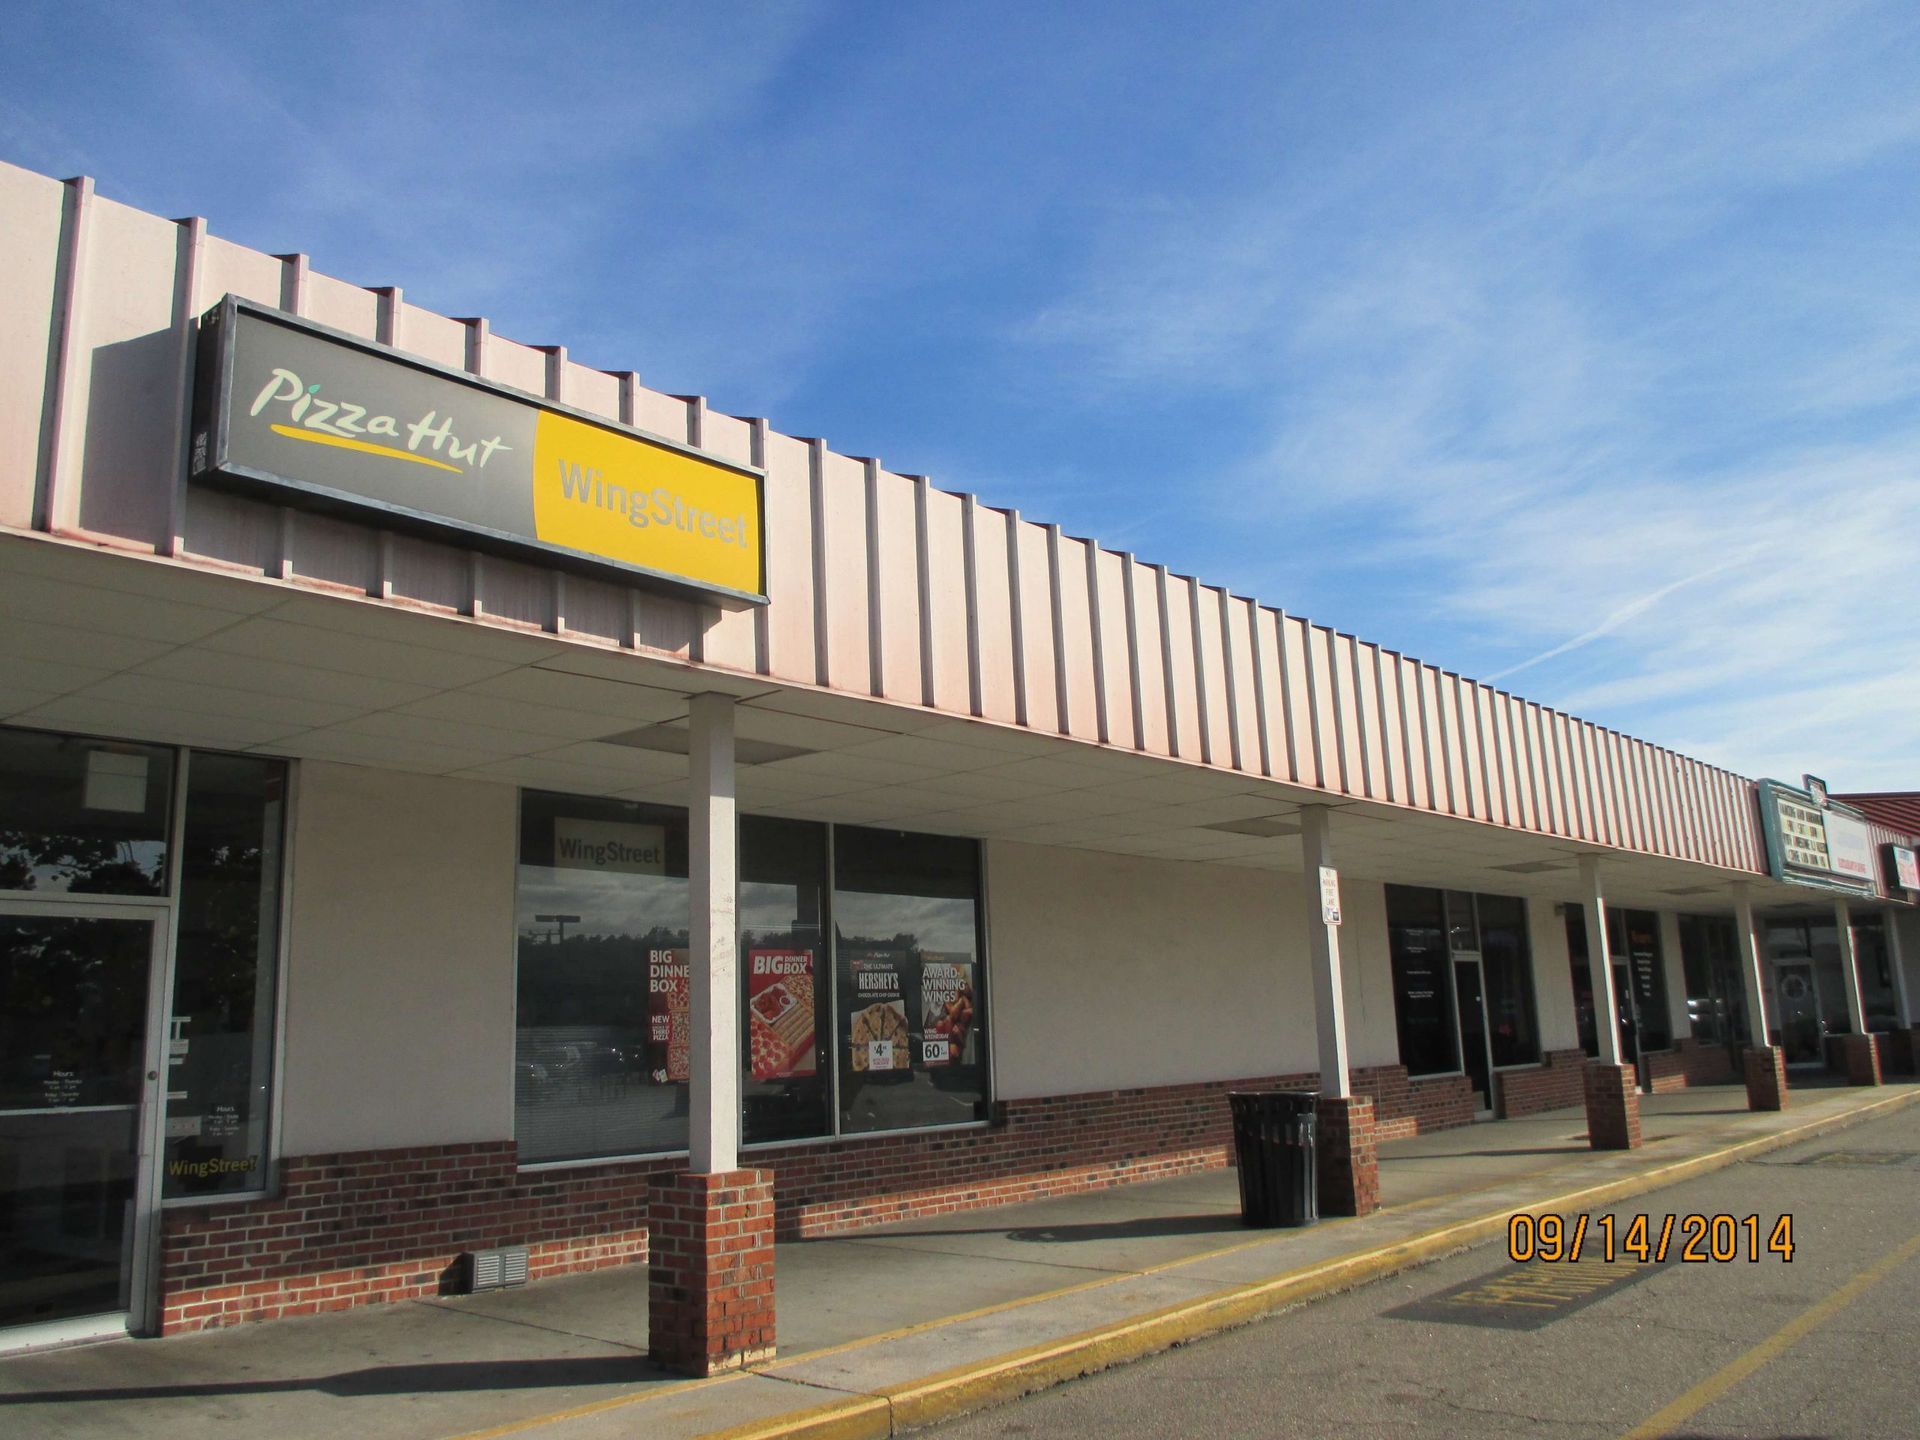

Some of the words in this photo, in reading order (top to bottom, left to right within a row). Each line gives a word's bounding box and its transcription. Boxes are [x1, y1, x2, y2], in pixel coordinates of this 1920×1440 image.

[250, 368, 399, 438] Pizza
[407, 409, 512, 468] Hut
[558, 457, 748, 549] WingStreet
[559, 837, 661, 865] WingStreet
[650, 949, 672, 964] BIG
[784, 955, 808, 963] DINNER
[650, 964, 690, 978] DINNE
[754, 955, 784, 975] BIG
[784, 962, 807, 975] BOX
[650, 979, 678, 993] BOX
[922, 978, 966, 991] WINNING
[922, 990, 956, 1004] WINGS
[652, 1015, 670, 1024] NEW
[168, 1155, 256, 1179] WingStreet
